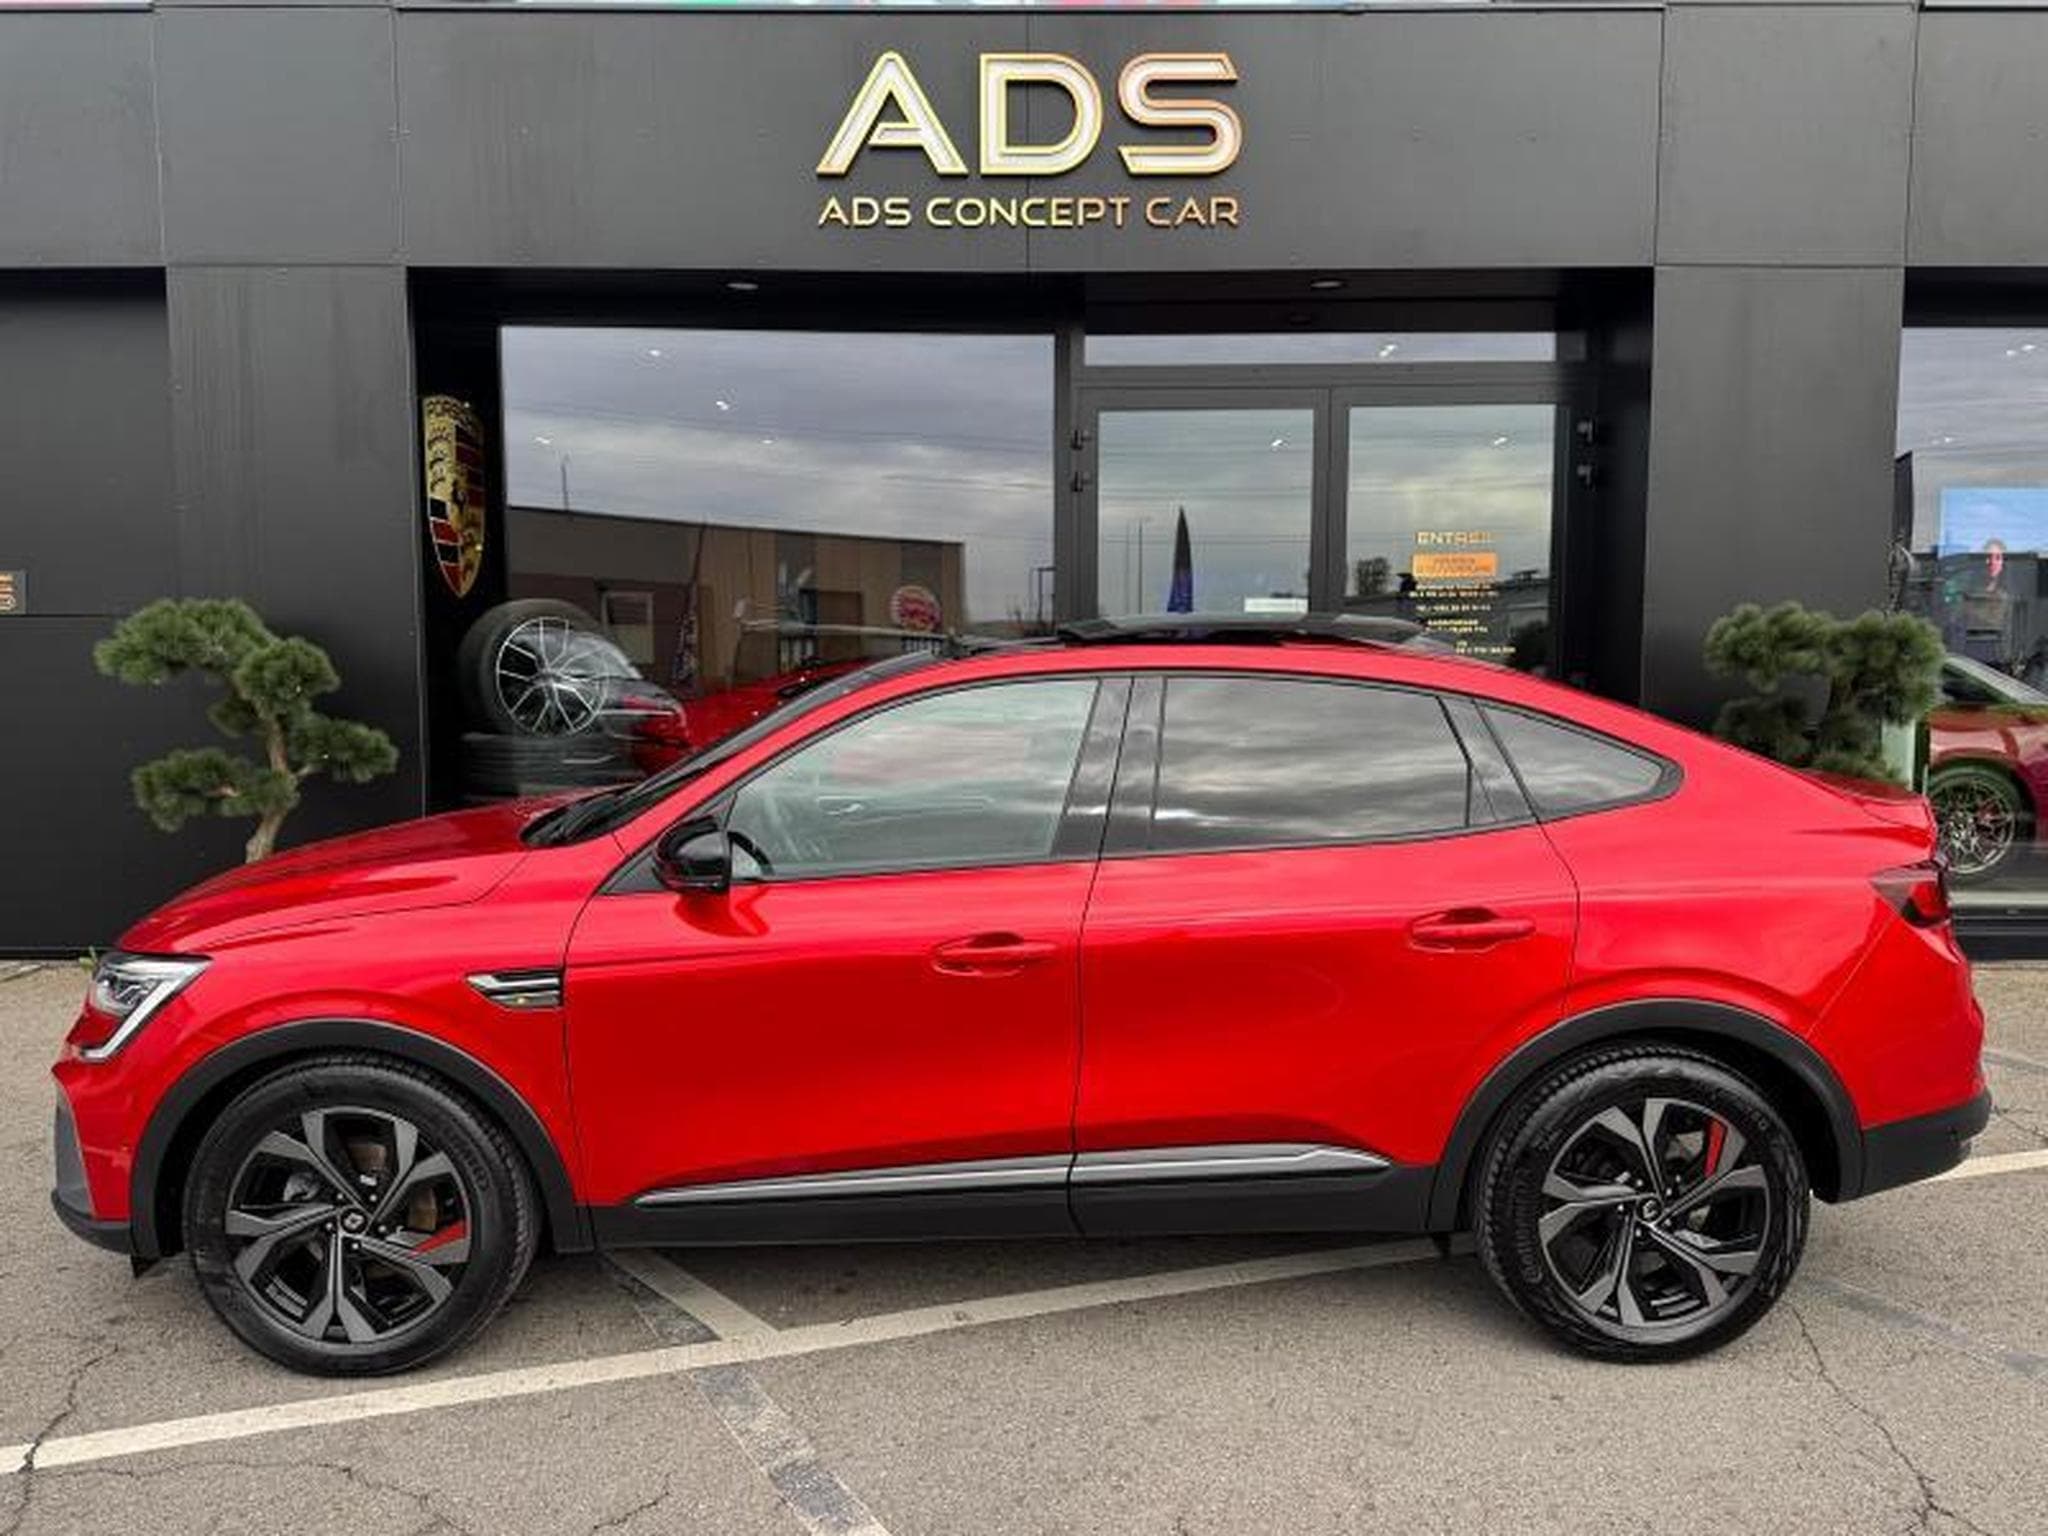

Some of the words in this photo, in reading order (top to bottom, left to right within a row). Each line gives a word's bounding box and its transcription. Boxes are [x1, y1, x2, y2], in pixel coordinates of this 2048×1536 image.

[816, 50, 1243, 175] ADS
[818, 197, 911, 227] ADS
[926, 197, 1130, 227] CONCEPT
[1146, 197, 1239, 226] CAR
